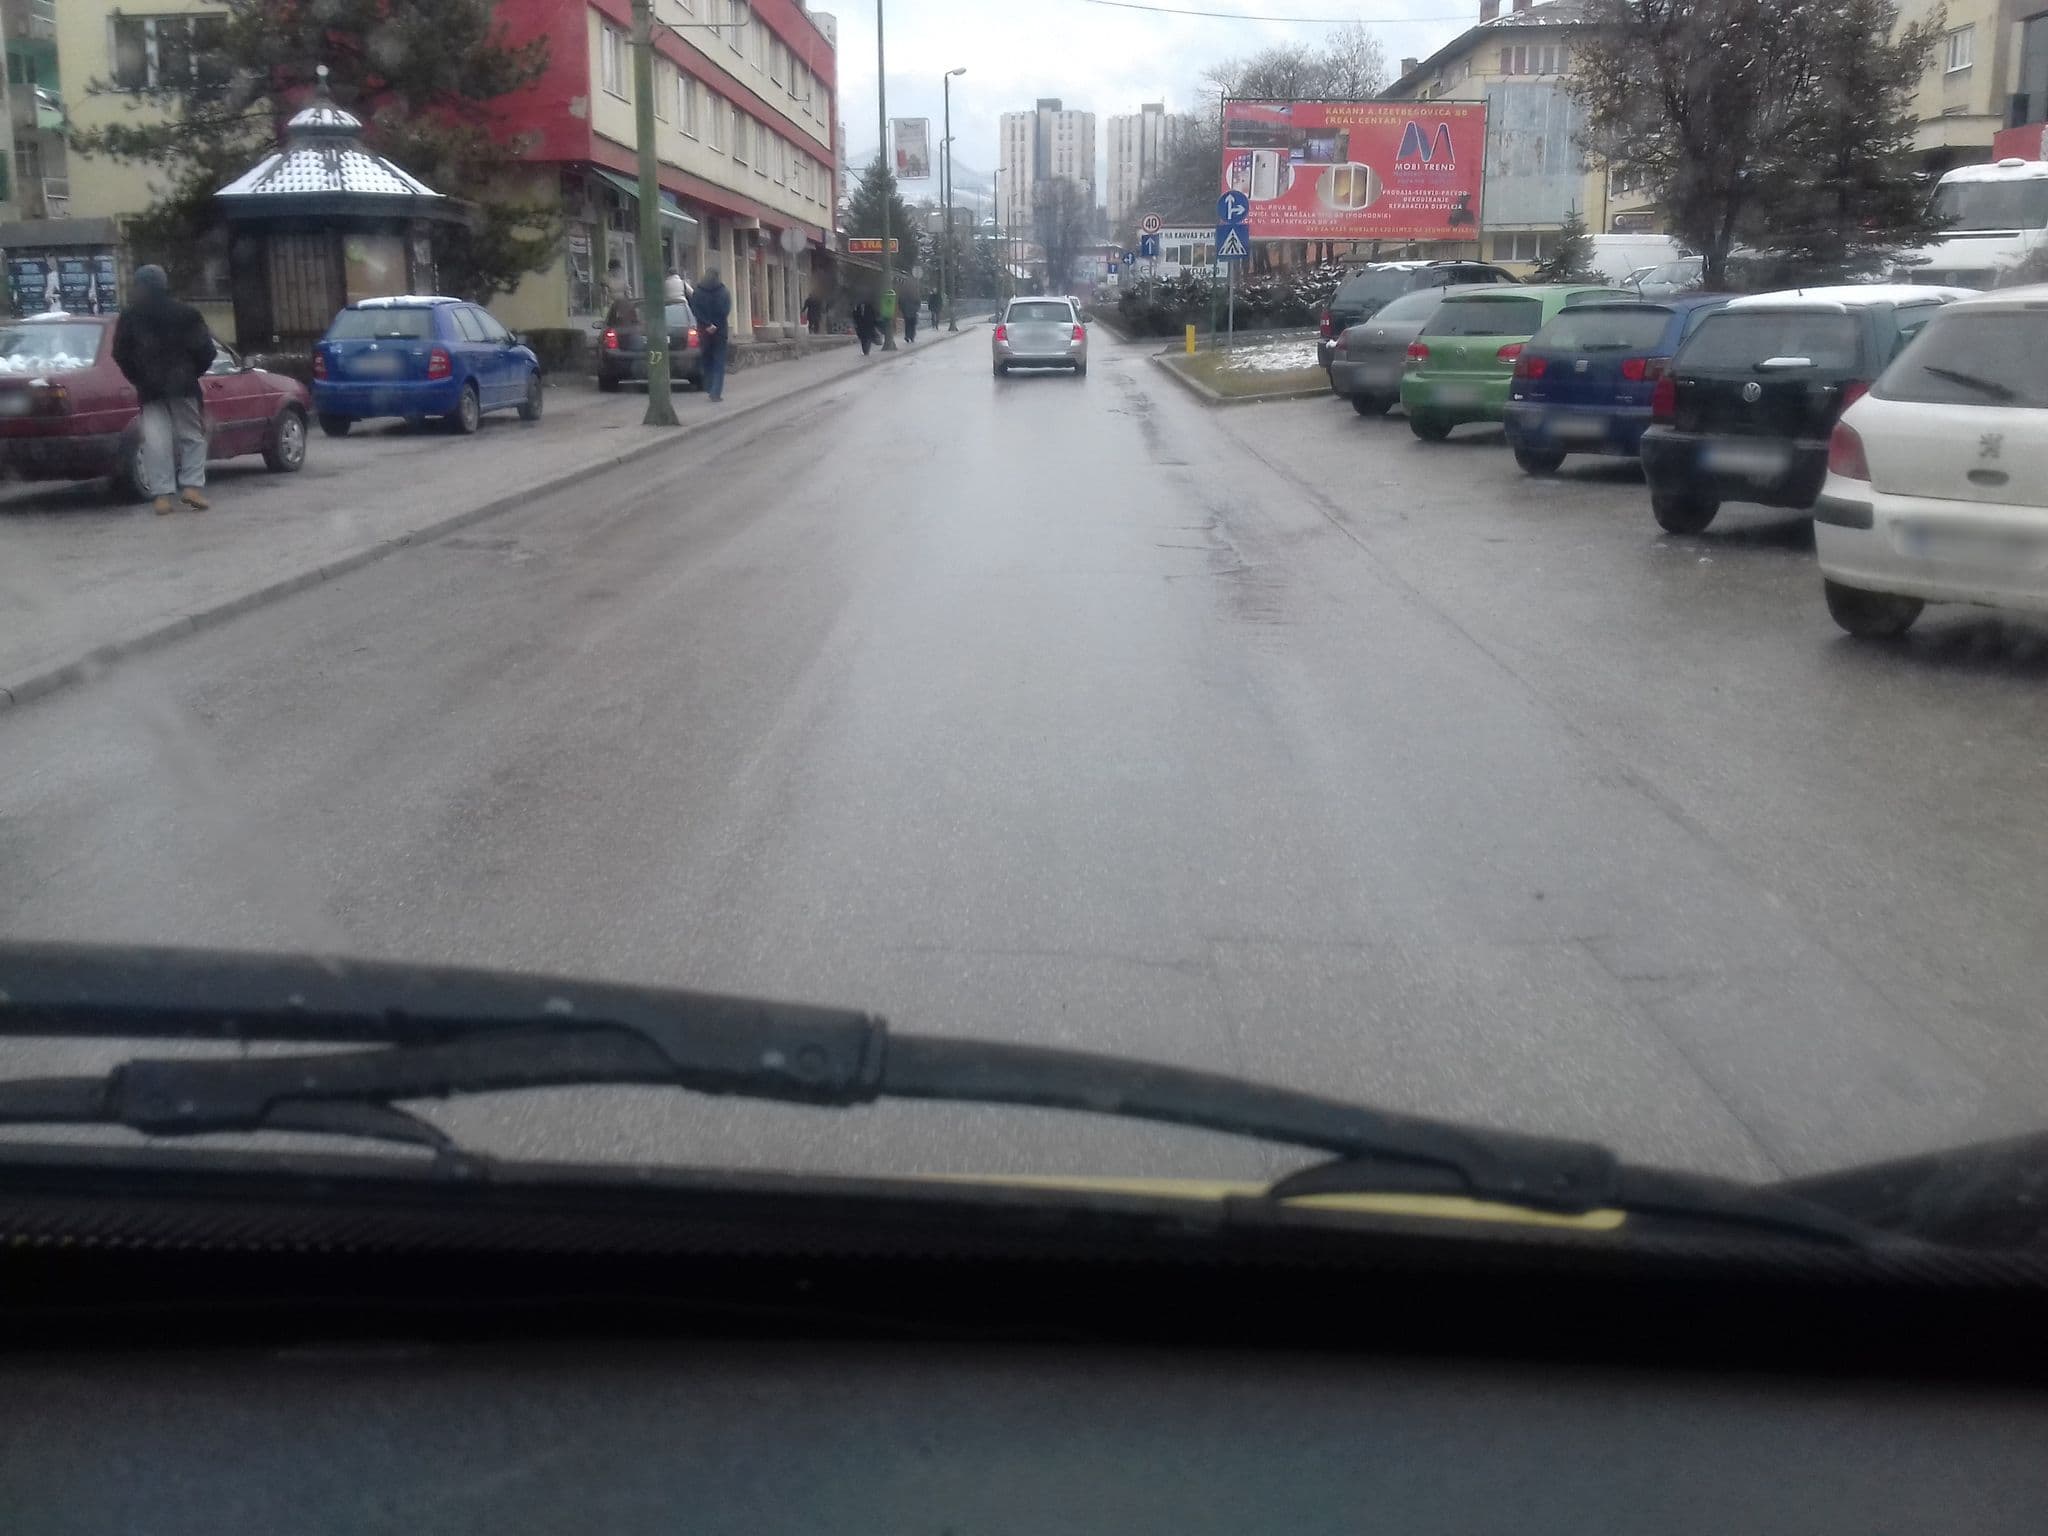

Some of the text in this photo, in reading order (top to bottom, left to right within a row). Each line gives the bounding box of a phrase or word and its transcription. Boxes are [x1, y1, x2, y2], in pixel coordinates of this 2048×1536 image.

[1394, 163, 1456, 171] MOBI TREND
[1145, 218, 1157, 229] 40
[648, 350, 662, 365] 27
